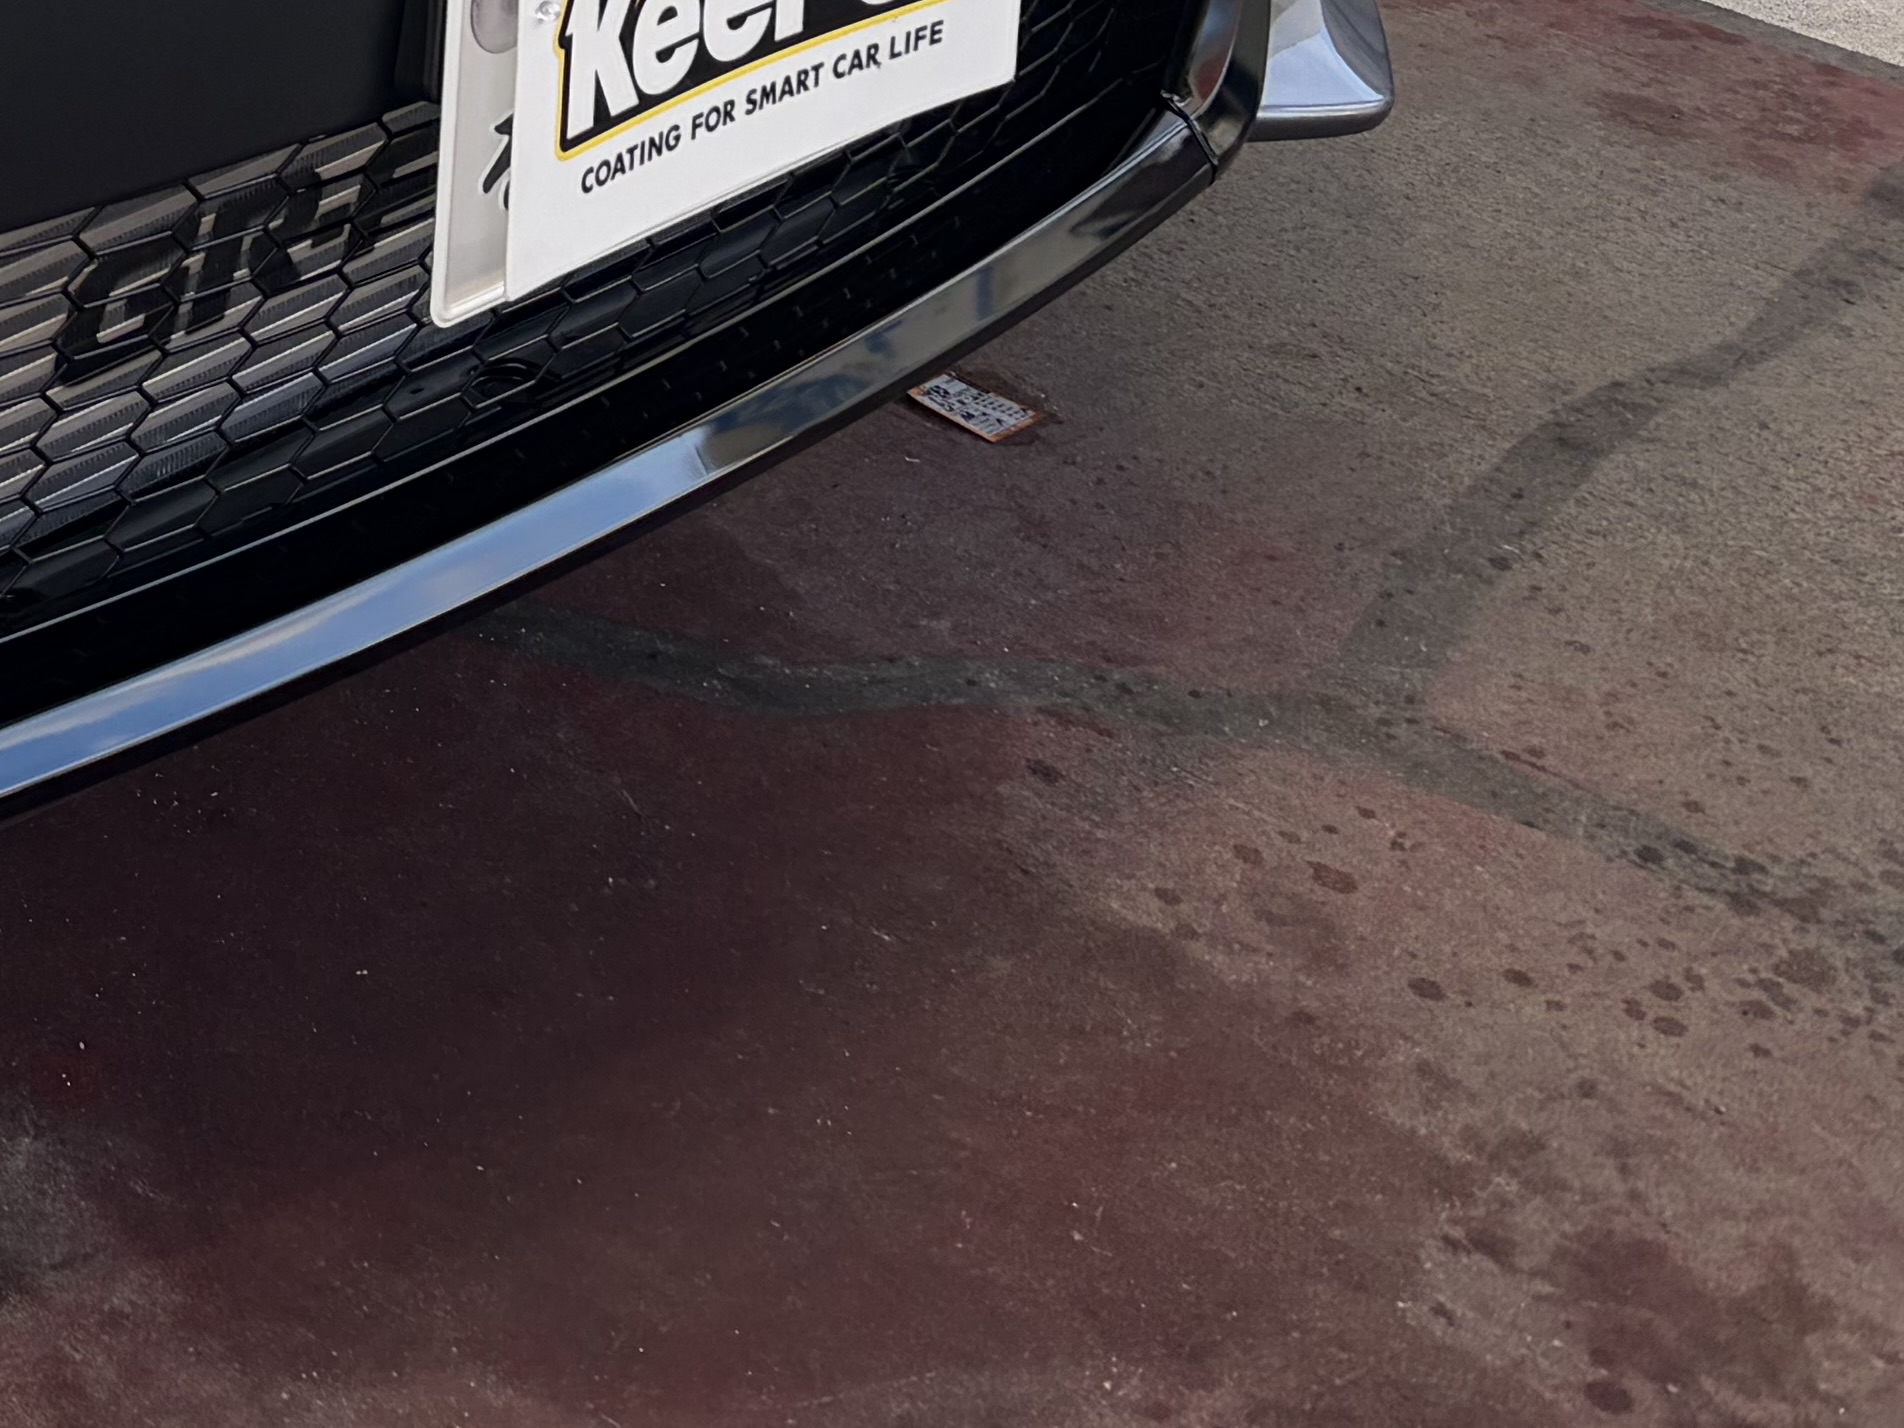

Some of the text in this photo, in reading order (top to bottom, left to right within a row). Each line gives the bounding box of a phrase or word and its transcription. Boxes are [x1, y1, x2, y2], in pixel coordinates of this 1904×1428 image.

[580, 21, 944, 195] COATING FOR SMART CAR LIFE
